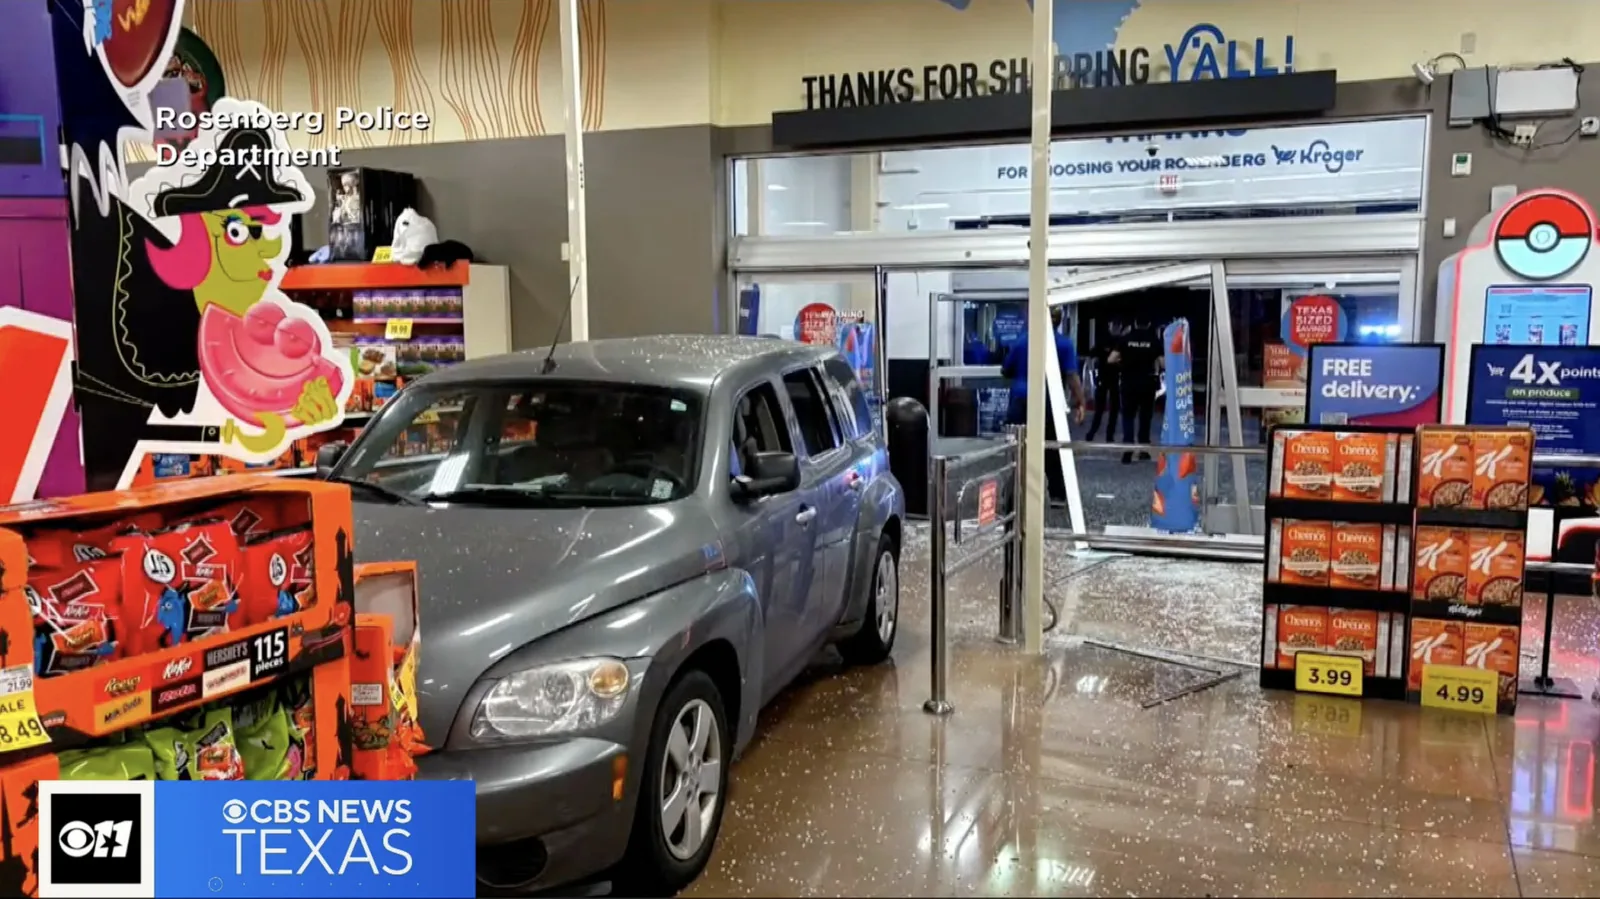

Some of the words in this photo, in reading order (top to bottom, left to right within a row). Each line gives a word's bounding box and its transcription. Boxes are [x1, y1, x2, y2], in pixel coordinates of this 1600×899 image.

[801, 67, 914, 110] THANKS
[923, 62, 978, 100] FOR
[989, 46, 1149, 95] SHPPING
[997, 165, 1028, 180] FOR
[1050, 160, 1113, 176] OOSING
[1118, 157, 1161, 173] YOUR
[1300, 138, 1364, 174] Kroger
[1295, 305, 1333, 315] TEXAS
[1295, 315, 1332, 325] SIZED
[1322, 358, 1372, 376] FREE
[1528, 388, 1572, 398] produce
[206, 642, 249, 667] HERSHEY'S
[254, 631, 286, 660] 115
[255, 657, 284, 675] pieces
[7, 678, 32, 693] 21.99
[1308, 666, 1352, 686] 3.99
[1436, 684, 1484, 704] 4.99
